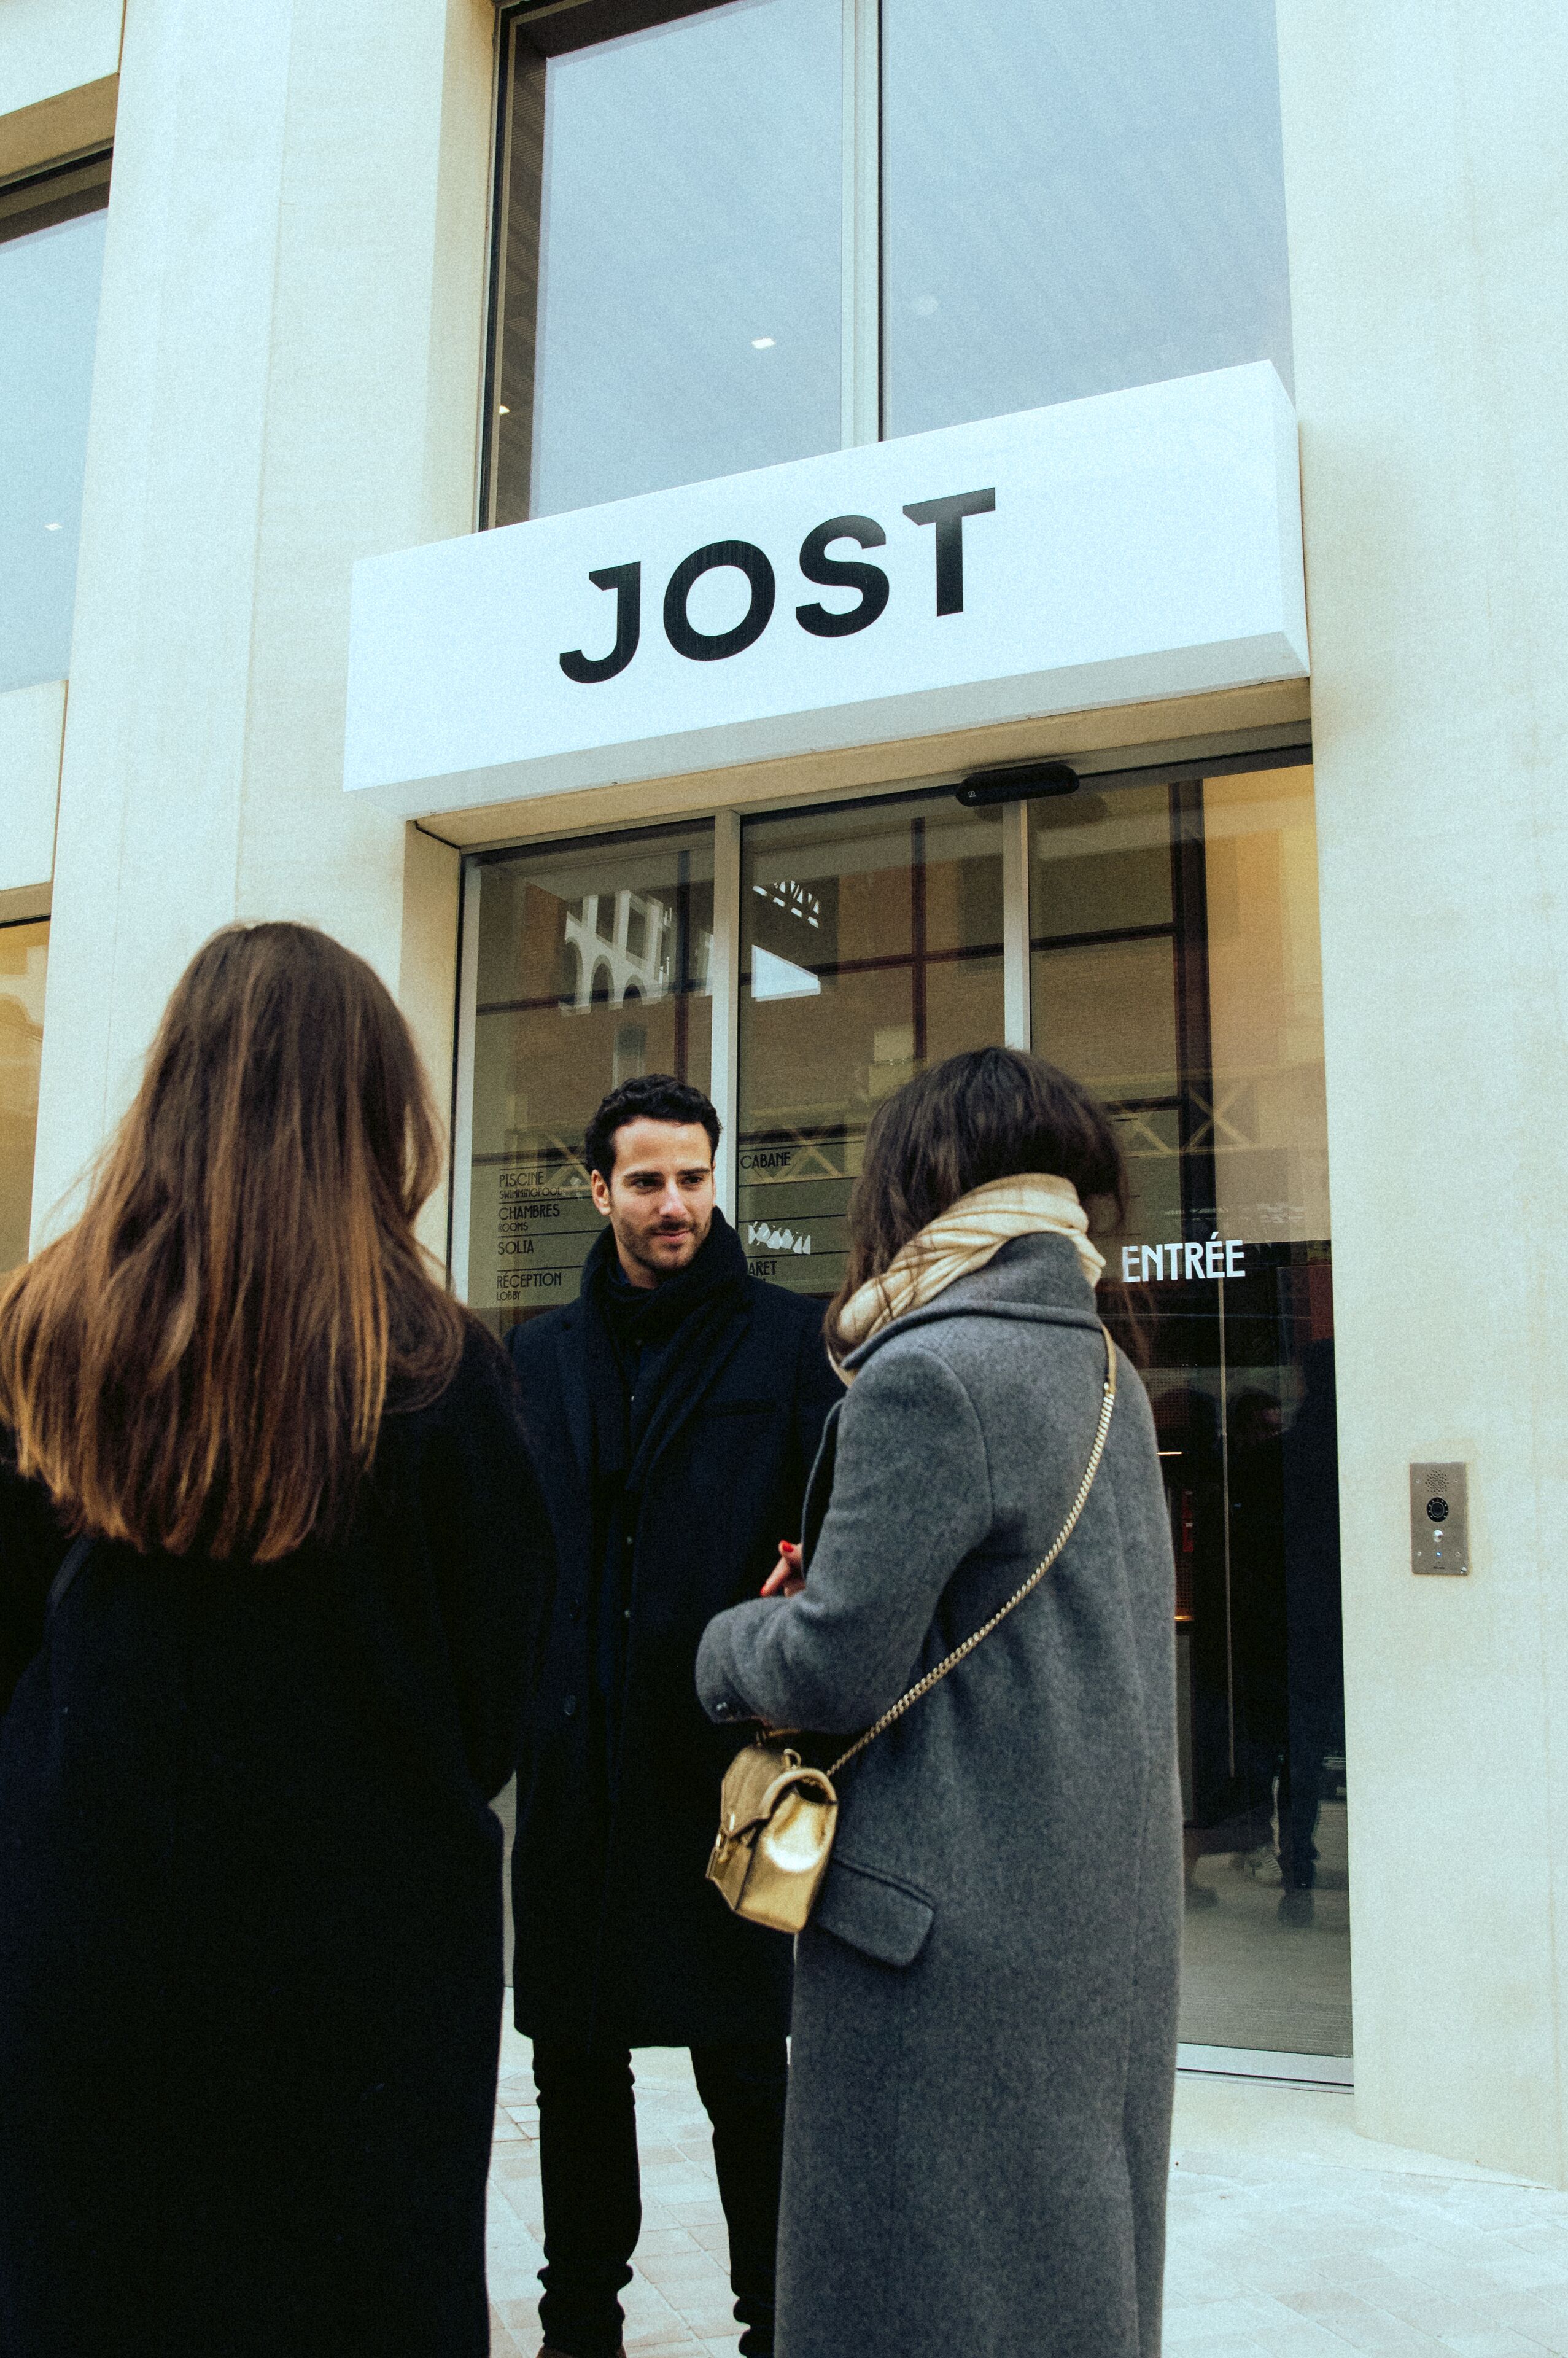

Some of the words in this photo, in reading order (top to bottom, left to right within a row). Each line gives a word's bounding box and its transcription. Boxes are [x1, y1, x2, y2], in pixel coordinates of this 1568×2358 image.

[559, 487, 996, 683] JOST
[740, 1152, 791, 1169] CABANE
[499, 1171, 544, 1187] PISCINE
[499, 1204, 560, 1220] CHAMBRES
[498, 1222, 529, 1232] ROOMS
[498, 1240, 534, 1255] SOLIA
[1122, 1232, 1246, 1283] ENTRÉE
[748, 1261, 777, 1276] ARET
[497, 1272, 562, 1289] RÉCEPTION
[497, 1291, 521, 1301] LOBBY
